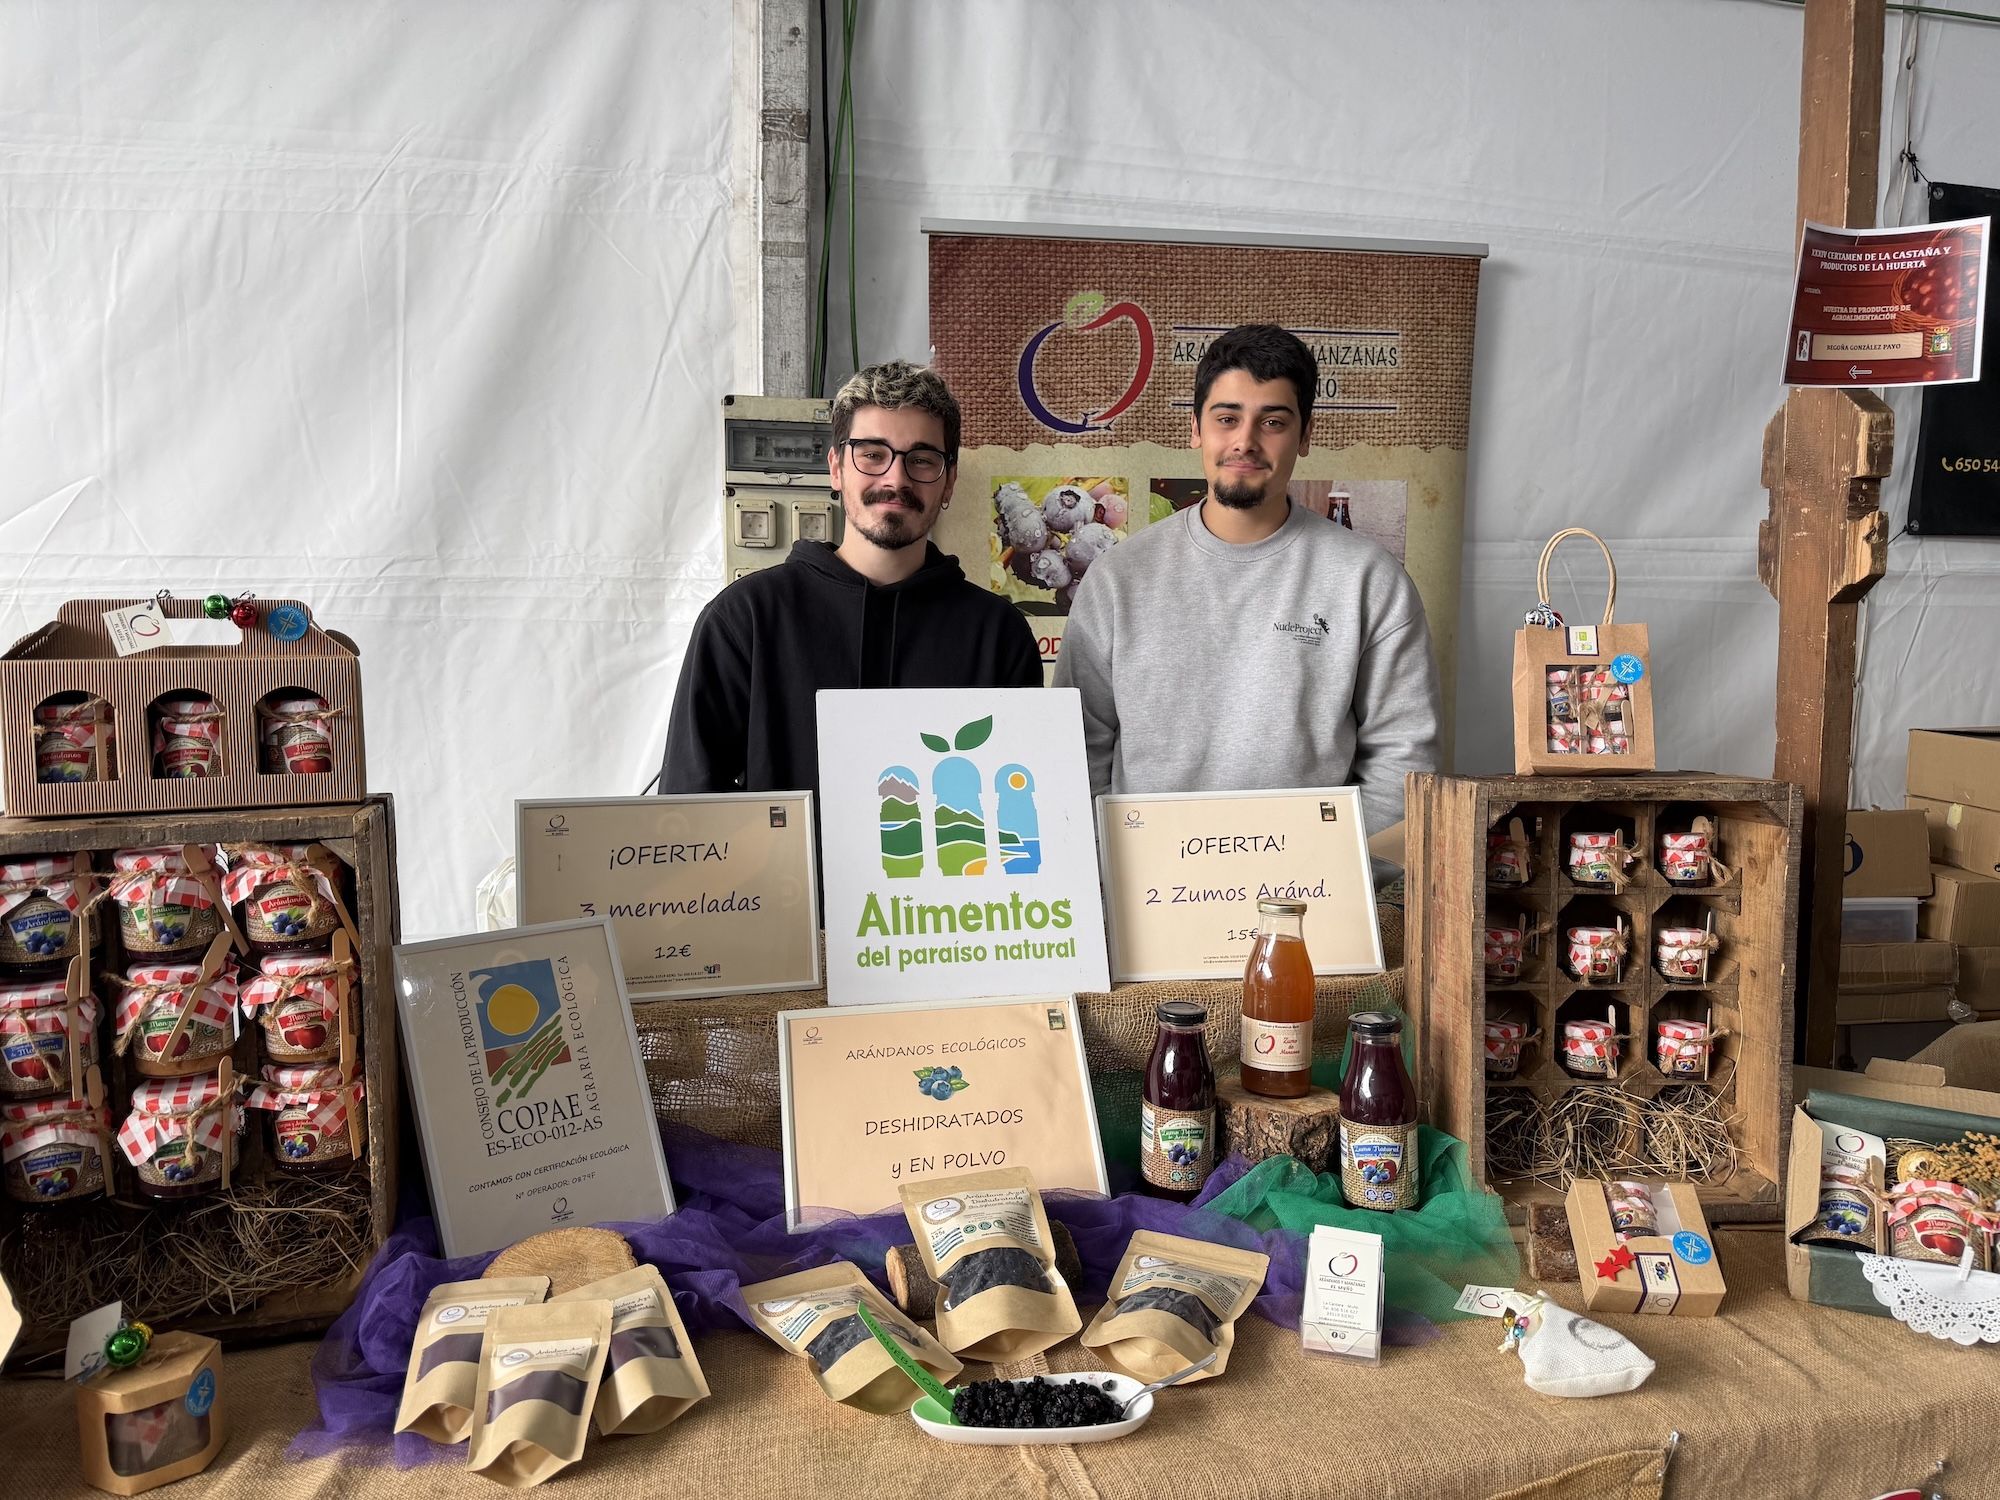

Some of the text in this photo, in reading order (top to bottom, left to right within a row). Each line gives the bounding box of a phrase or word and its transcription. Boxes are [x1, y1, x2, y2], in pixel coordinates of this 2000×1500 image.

[1820, 260, 1926, 271] PRODUCTOS DE LA HUERTA
[1828, 251, 1862, 261] CERTAMEN
[1864, 252, 1876, 261] DE
[1878, 252, 1890, 260] LA
[1892, 247, 1940, 259] CASTAÑA
[1942, 246, 1951, 255] Y
[1823, 305, 1849, 313] MUESTRA
[1858, 305, 1899, 313] PRODUCTOS
[1899, 304, 1911, 312] DE
[1832, 312, 1897, 321] AGROALIMENTACIÓN
[1826, 342, 1901, 351] BEGOÑA GONZÁLEZ PAYO
[1955, 457, 2000, 473] 650 54
[1272, 621, 1322, 635] NudeProject
[609, 842, 729, 870] ¡OFERTA!
[1180, 834, 1286, 859] ¡OFERTA!
[580, 891, 761, 918] 3 mermeladas
[1146, 879, 1331, 905] 2 Zumos Aránd.
[856, 891, 1073, 937] Alimentos
[1227, 928, 1258, 941] 15€
[654, 943, 691, 960] 12€
[857, 937, 1076, 972] del paraíso natural
[557, 955, 601, 1111] AGRARIA ECOLÓGICA
[450, 972, 495, 1140] CONSEJO DE LA PRODUCCIÓN
[845, 1036, 1027, 1062] ARÁNDANOS ECOLÓGICOS
[498, 1093, 584, 1136] COPAE
[865, 1109, 1024, 1136] DESHIDRATADOS
[486, 1116, 604, 1158] ES-ECO-012-AS
[468, 1144, 630, 1193] CONTAMOS CON CERTIFICACIÓN ECOLÓGICA
[891, 1150, 1006, 1179] y EN POLVO
[526, 1180, 570, 1197] OPERADOR:
